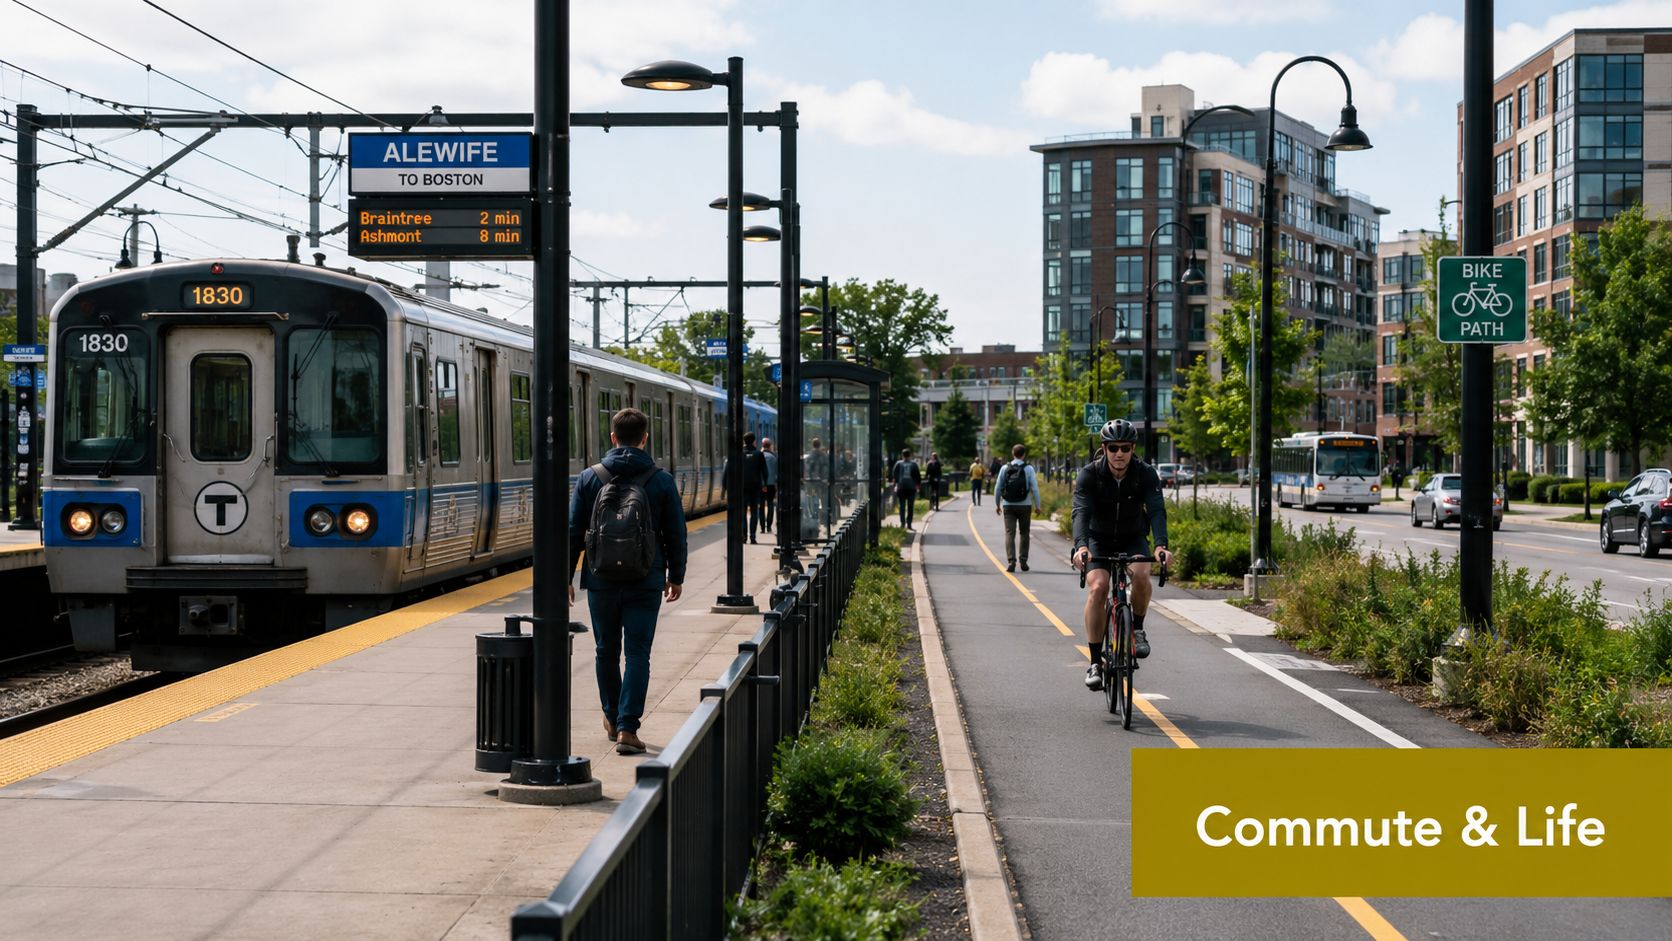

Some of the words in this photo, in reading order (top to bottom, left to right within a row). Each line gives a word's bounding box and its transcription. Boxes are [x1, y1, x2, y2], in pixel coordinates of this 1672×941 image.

[383, 141, 498, 163] ALEWIFE
[398, 173, 418, 186] TO
[423, 173, 483, 186] BOSTON
[360, 211, 432, 225] Braintree
[480, 211, 489, 225] 2
[494, 211, 520, 225] min
[360, 229, 422, 243] Ashmont
[479, 229, 489, 243] 8
[494, 229, 520, 243] min
[1462, 263, 1503, 278] BIKE
[192, 286, 243, 305] 1830
[1460, 321, 1504, 336] PATH
[79, 333, 129, 352] 1830
[204, 494, 238, 526] T
